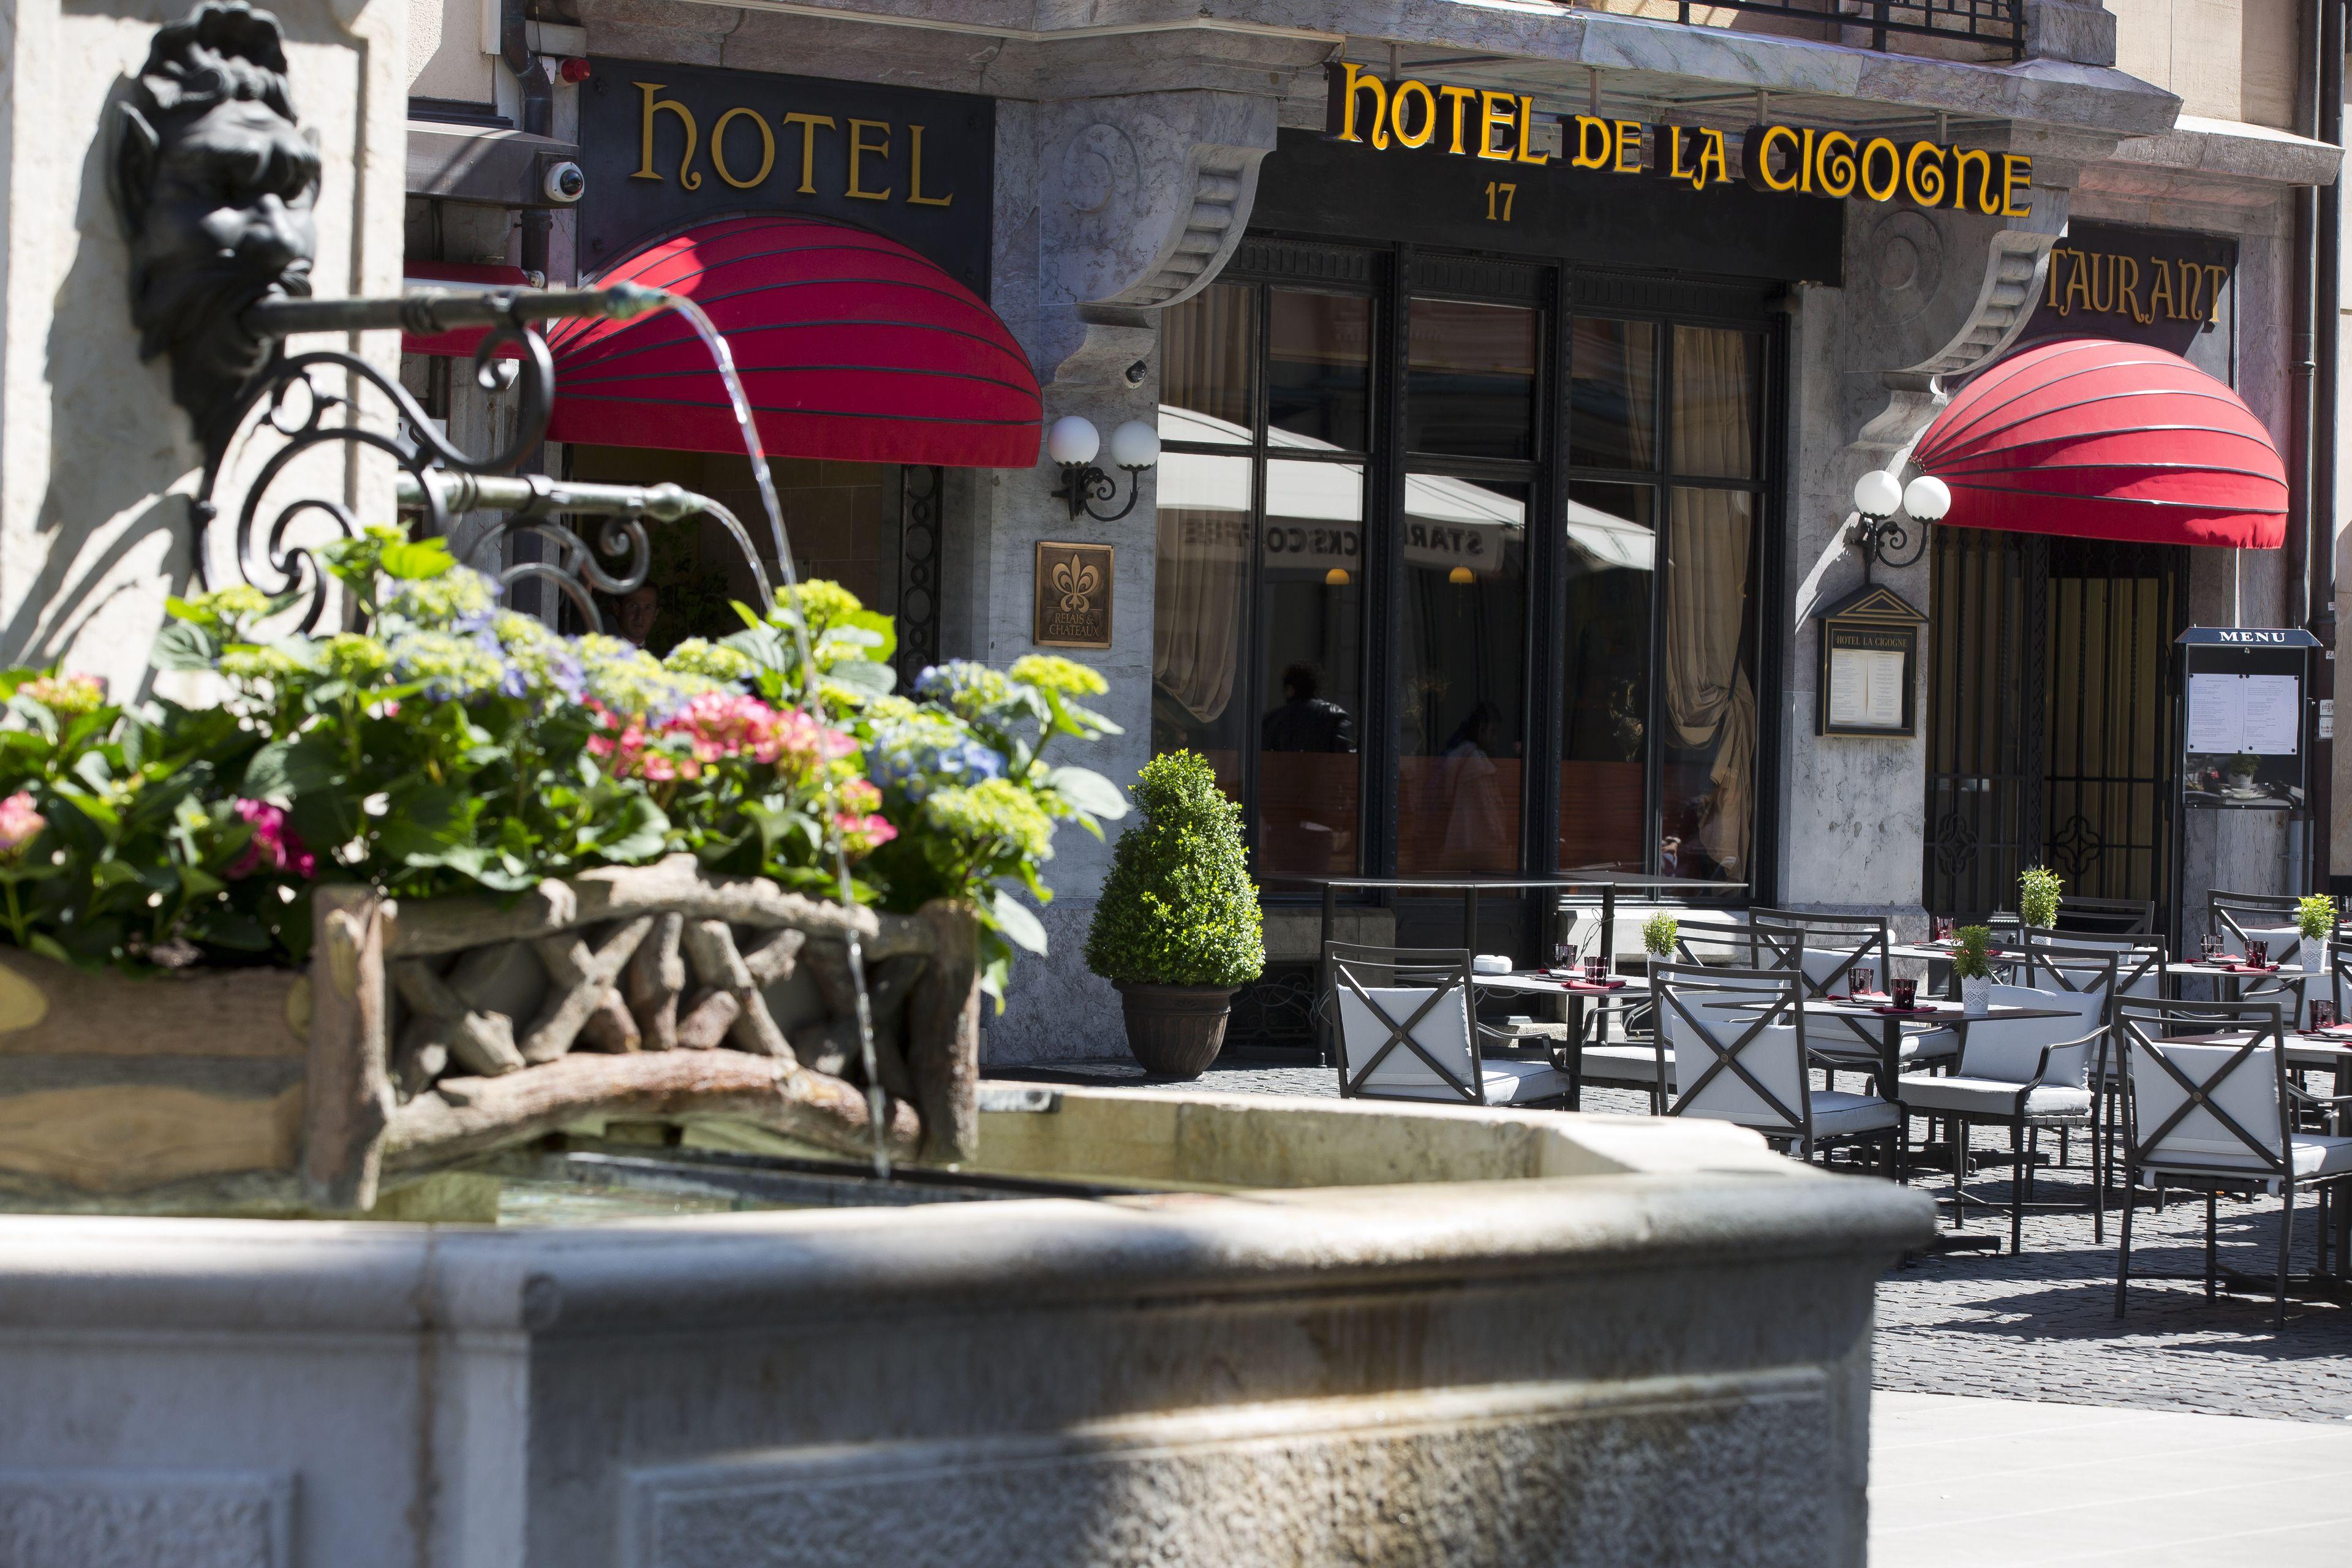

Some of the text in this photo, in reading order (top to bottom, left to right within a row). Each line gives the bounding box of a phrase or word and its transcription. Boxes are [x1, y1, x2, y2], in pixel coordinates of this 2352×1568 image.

[630, 81, 952, 206] HOTEL
[1338, 62, 2033, 217] HOTEL DE LA CIGOGNE
[1485, 181, 1517, 222] 17
[1054, 612, 1094, 625] RELAIS &
[1863, 636, 1873, 646] LA
[2218, 631, 2286, 643] MENU
